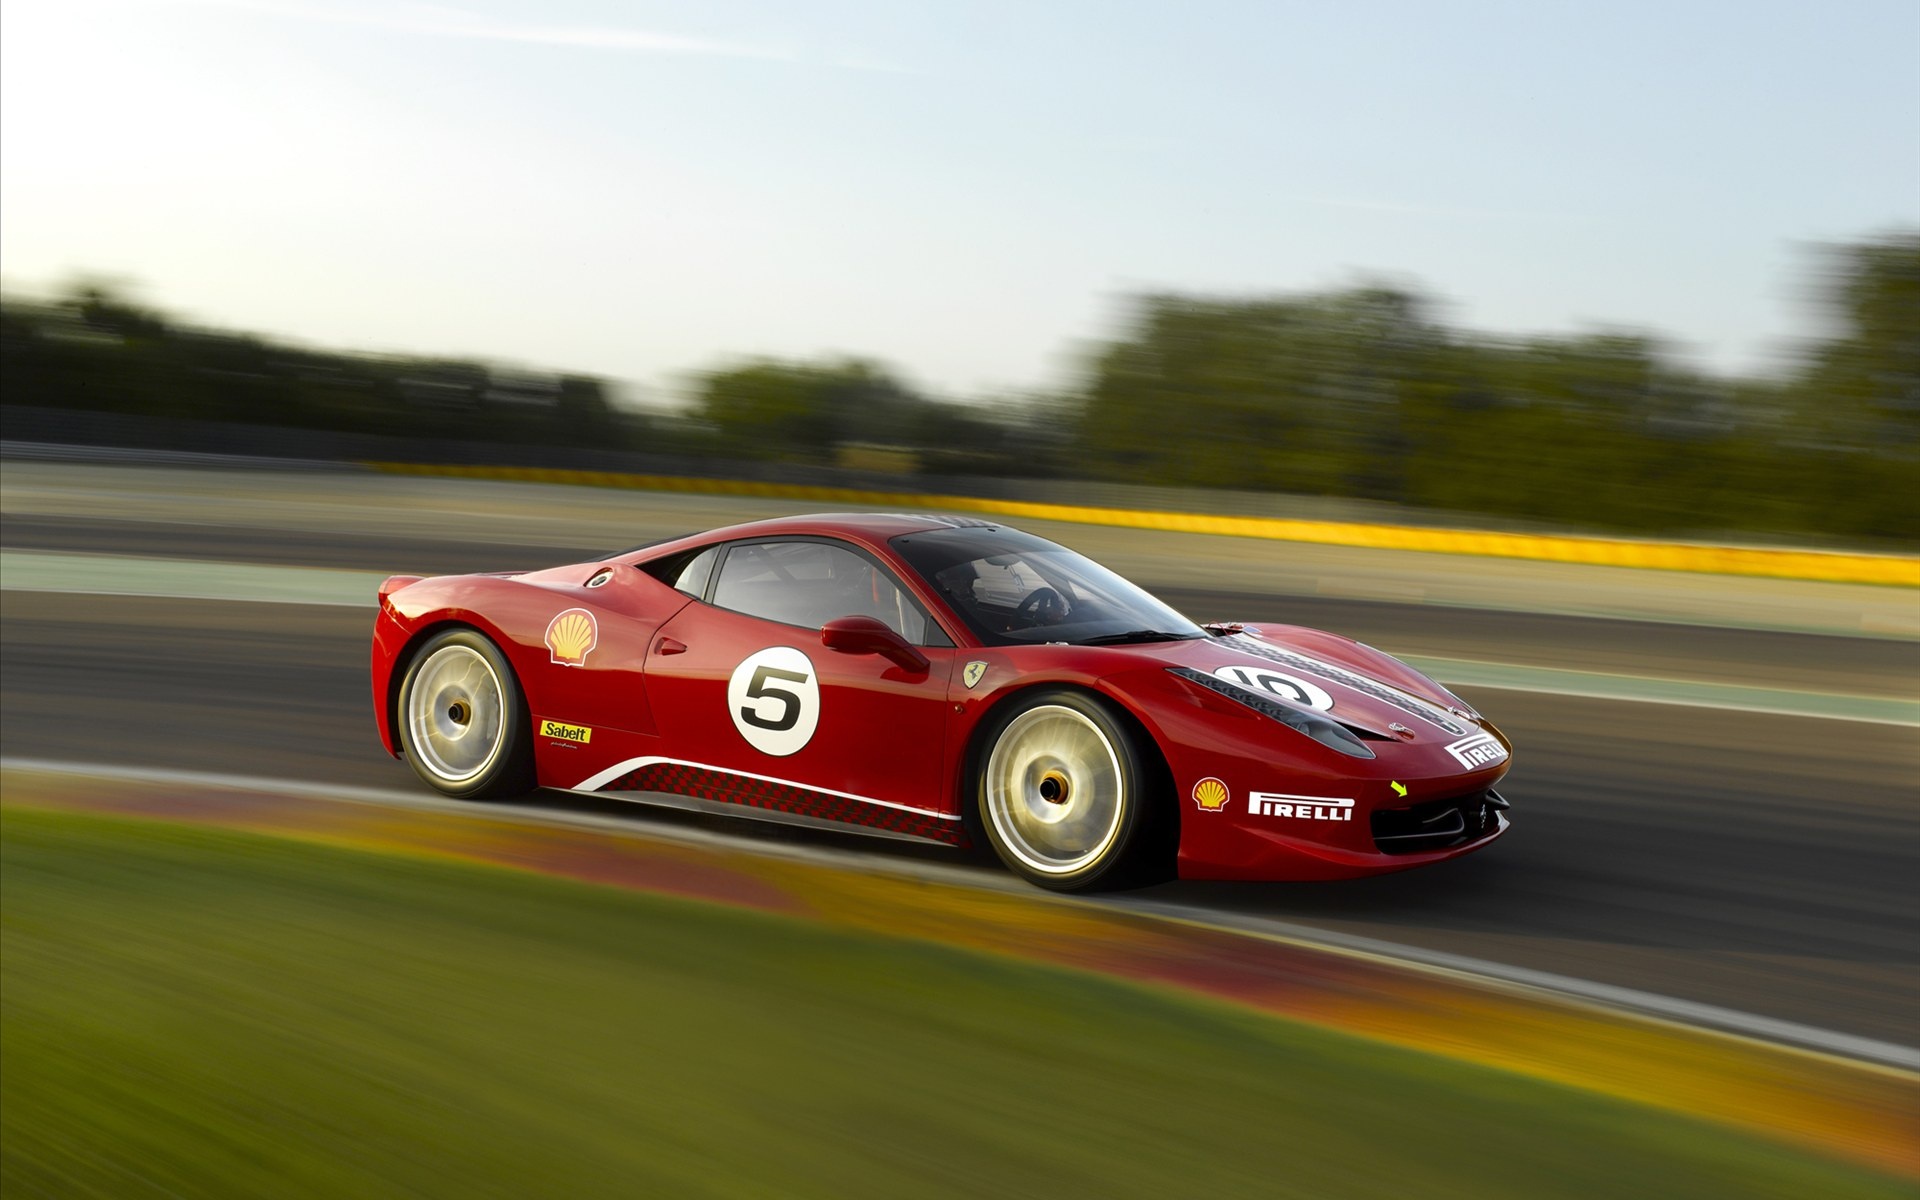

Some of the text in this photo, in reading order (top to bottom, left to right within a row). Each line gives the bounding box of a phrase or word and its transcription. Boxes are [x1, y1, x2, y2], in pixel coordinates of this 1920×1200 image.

[741, 665, 808, 731] 5
[545, 722, 586, 741] Sabelt
[1444, 733, 1509, 771] PIRELL
[1248, 791, 1355, 821] PIRELLI
